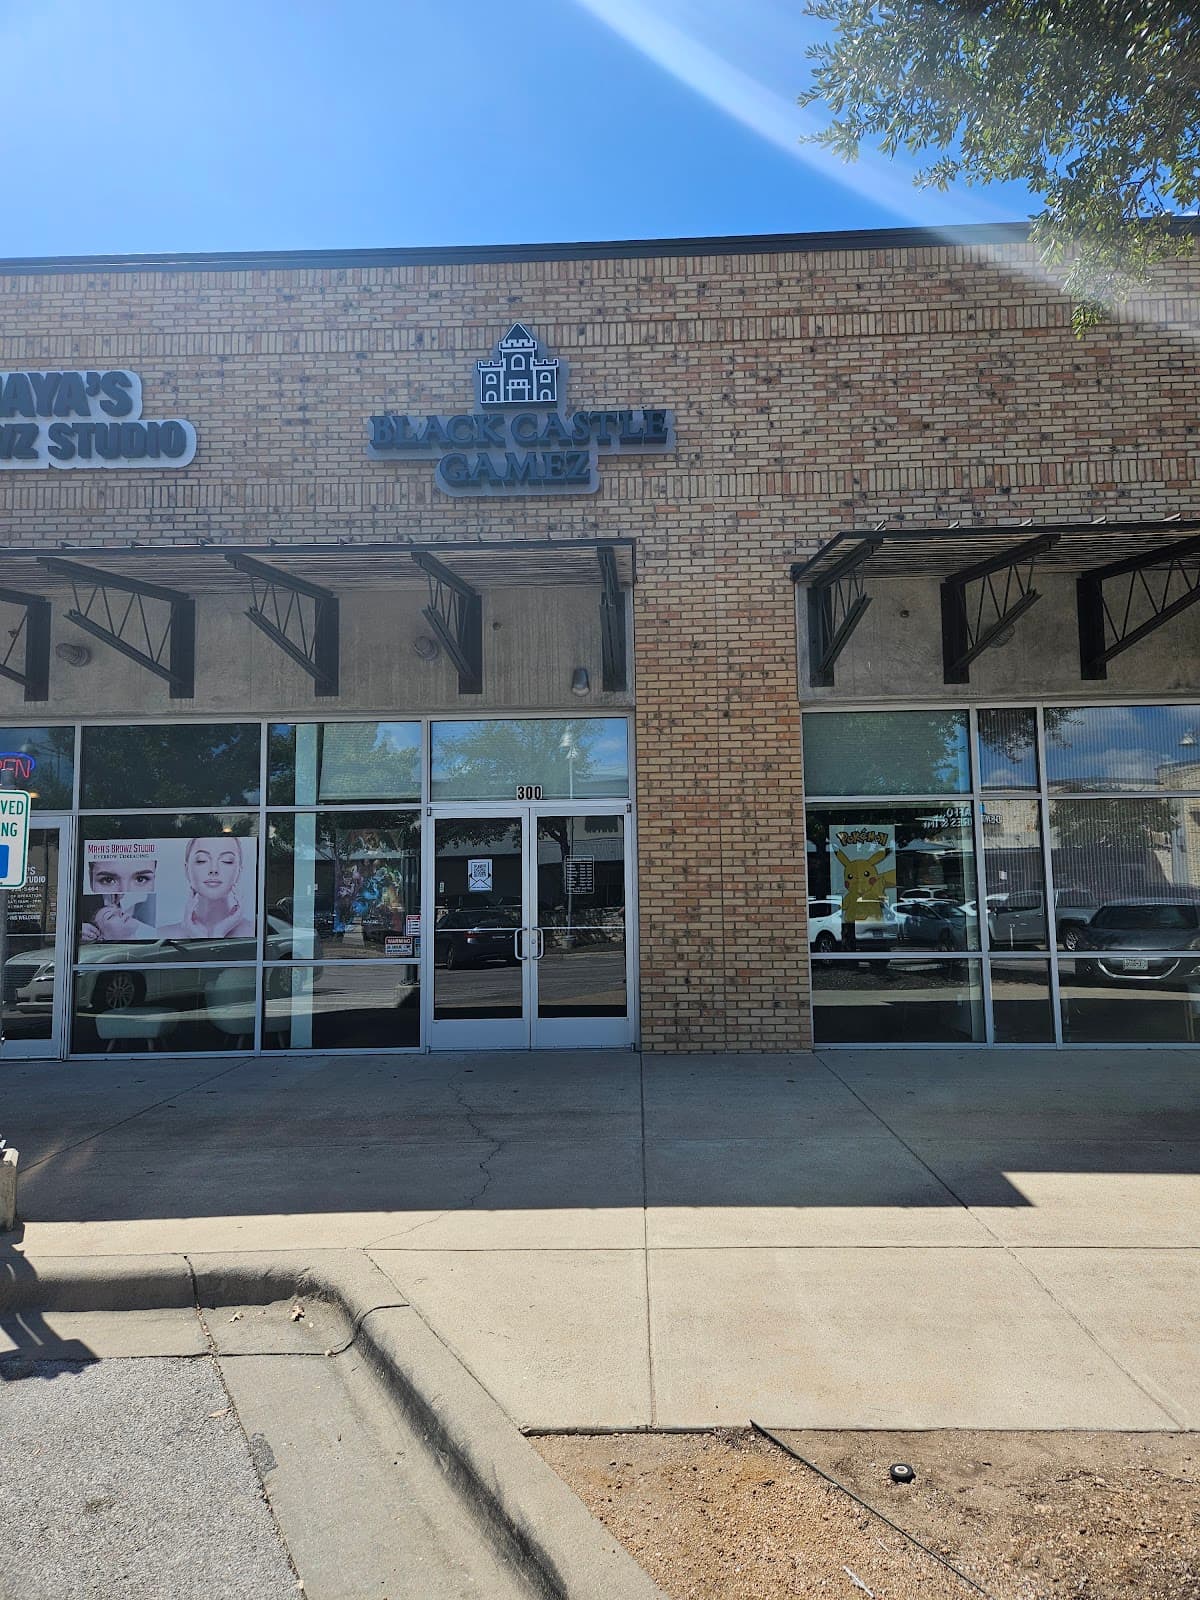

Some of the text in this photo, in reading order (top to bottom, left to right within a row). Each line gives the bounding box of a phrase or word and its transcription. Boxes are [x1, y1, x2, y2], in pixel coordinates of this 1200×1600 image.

[0, 371, 133, 417] AYA'S
[48, 420, 187, 460] STUDIO
[369, 409, 669, 448] BLACK CASTLE
[440, 450, 590, 487] GAMEZ
[0, 758, 31, 779] EN
[517, 786, 541, 800] 300
[133, 843, 155, 853] STUDIO
